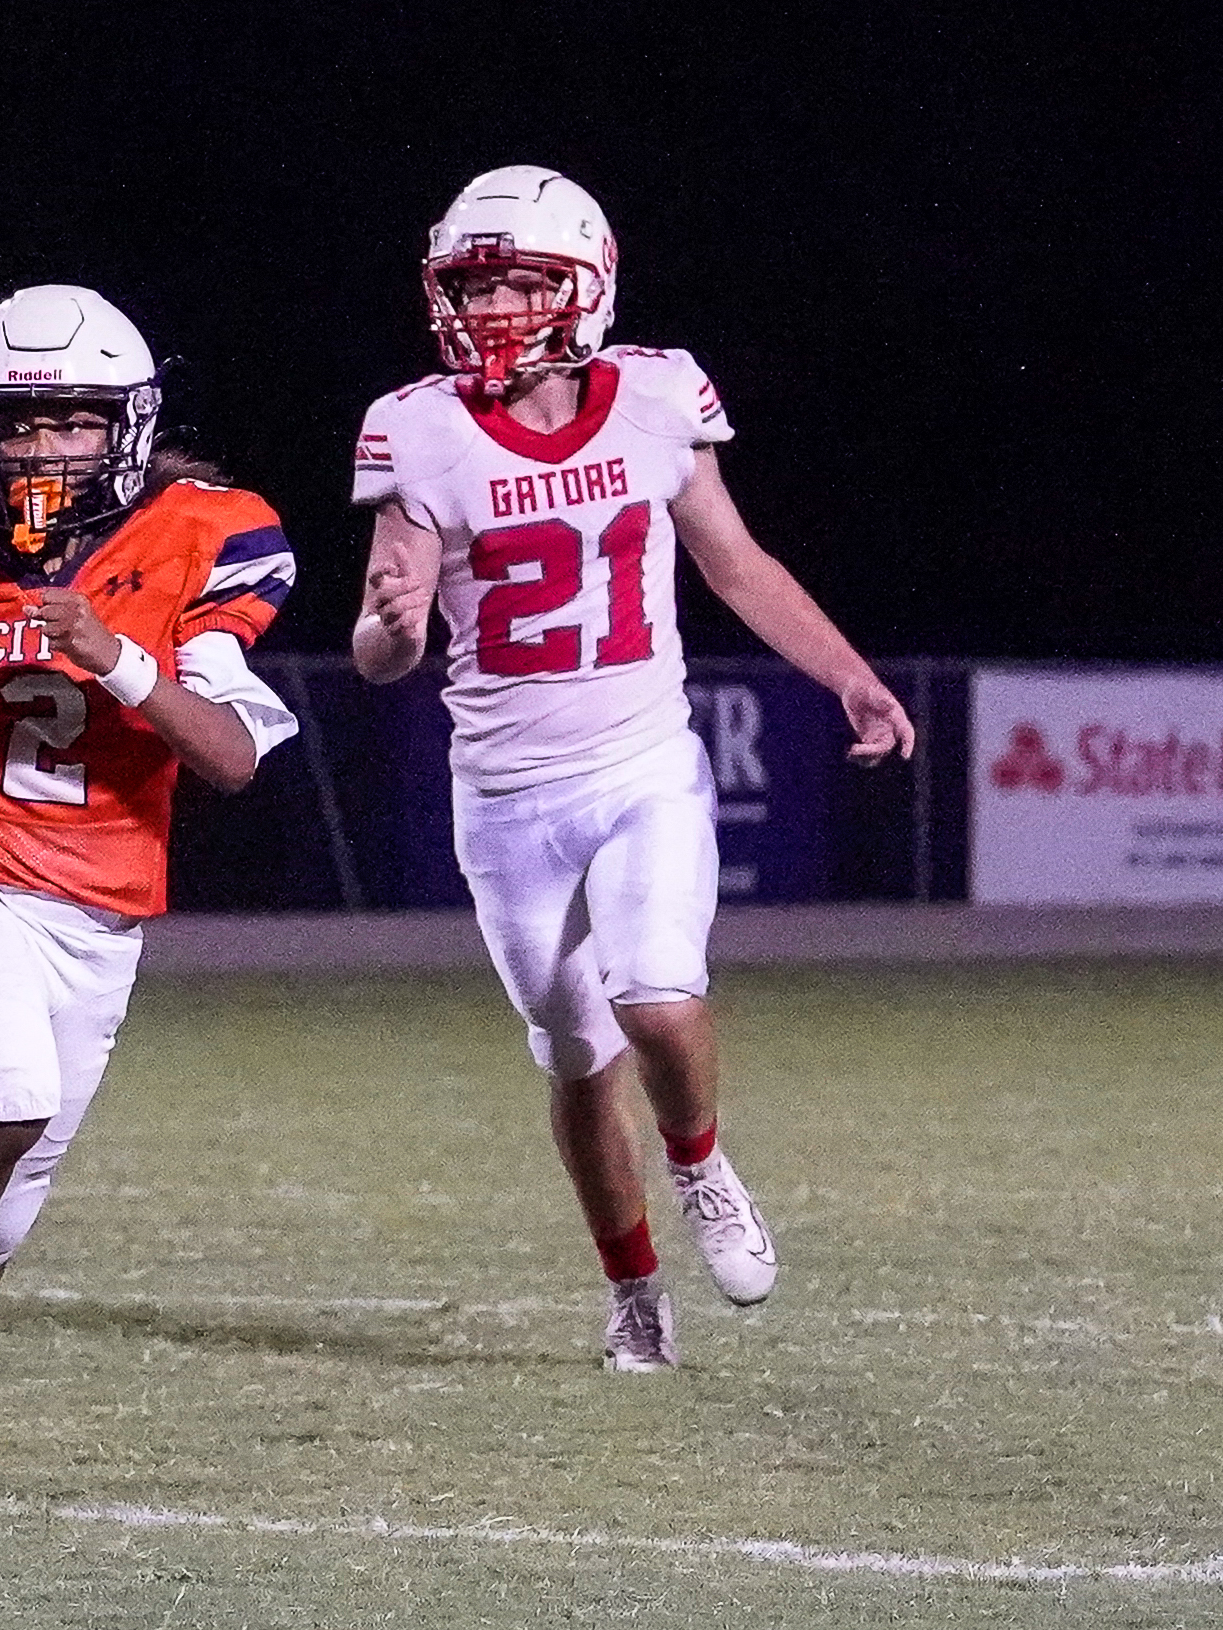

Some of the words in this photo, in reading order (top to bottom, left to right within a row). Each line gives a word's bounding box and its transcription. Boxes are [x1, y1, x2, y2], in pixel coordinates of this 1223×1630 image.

[8, 369, 61, 382] Riddell
[489, 457, 630, 517] GATORS
[469, 501, 654, 676] 21
[1, 675, 87, 806] 2
